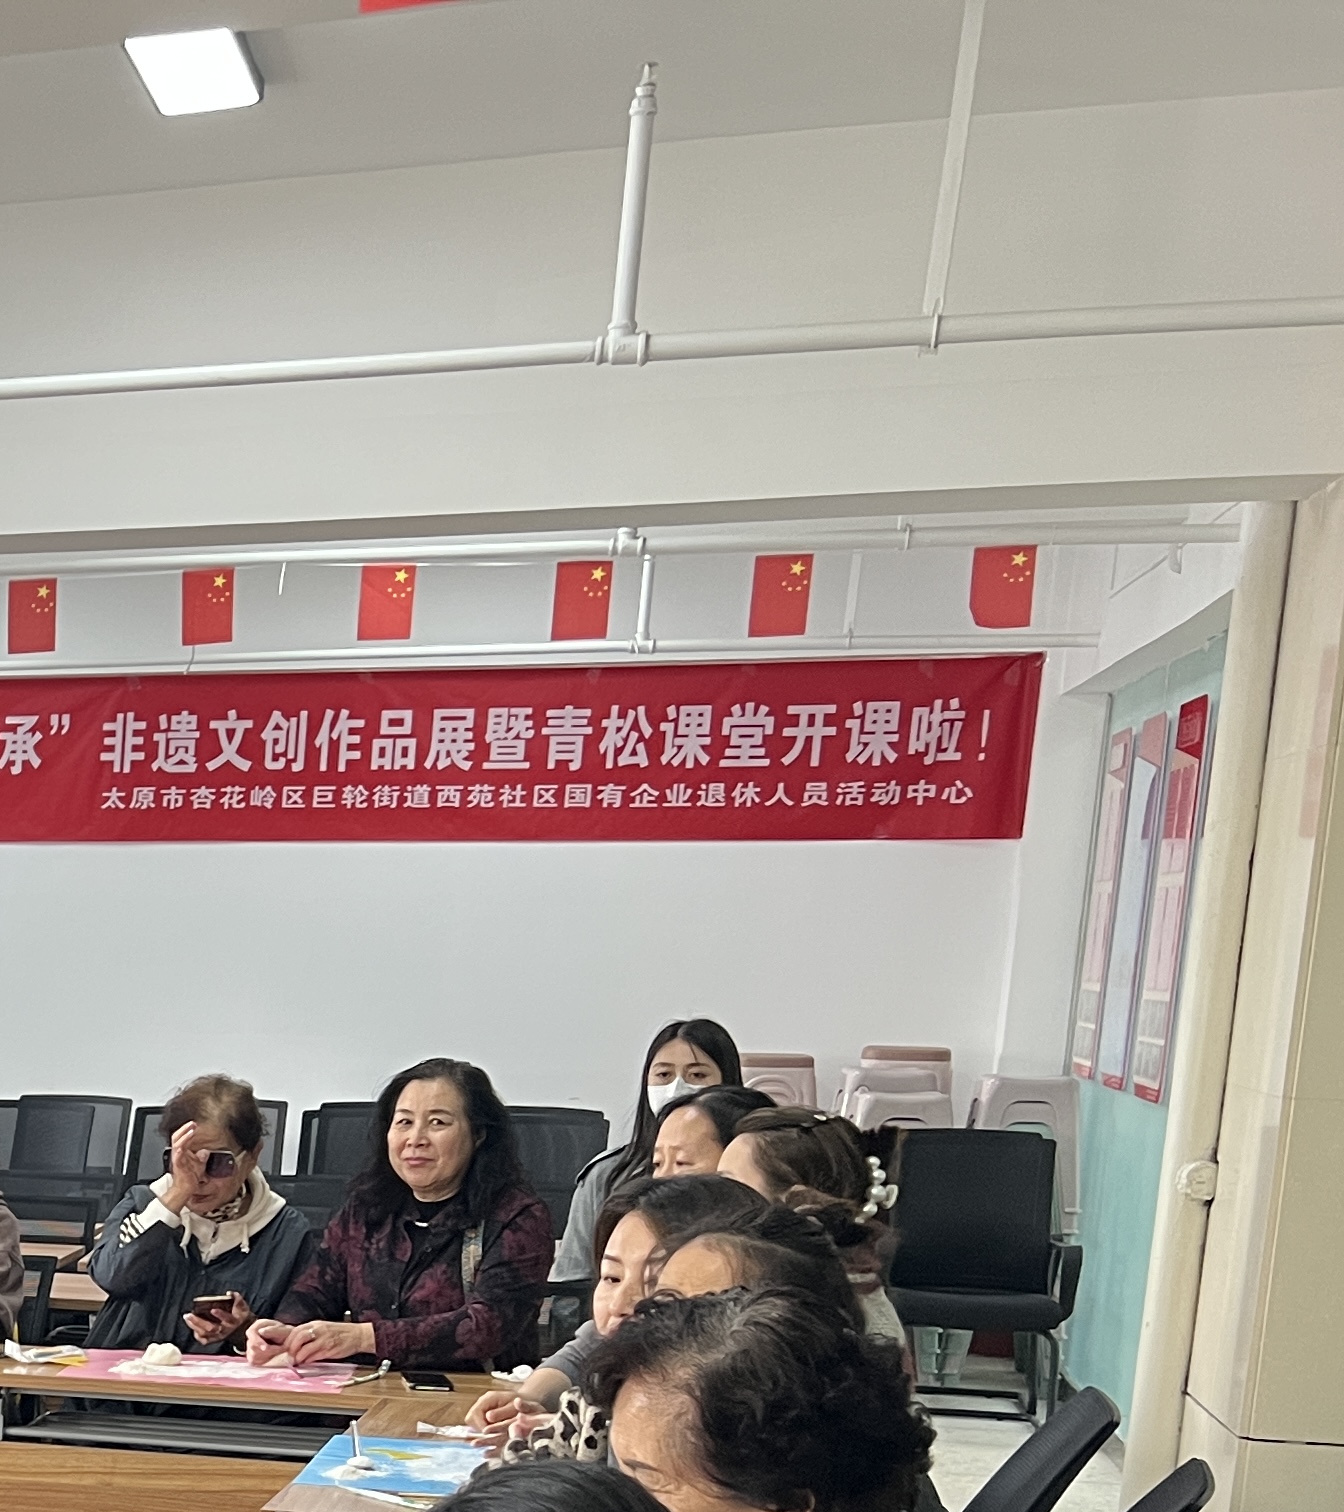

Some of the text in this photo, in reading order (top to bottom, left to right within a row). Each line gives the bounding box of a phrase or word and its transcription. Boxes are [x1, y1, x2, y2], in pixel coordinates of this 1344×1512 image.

[100, 779, 974, 810] 太原市杏花岭区巨轮街道西苑社区国有企业退休人员活动中心
